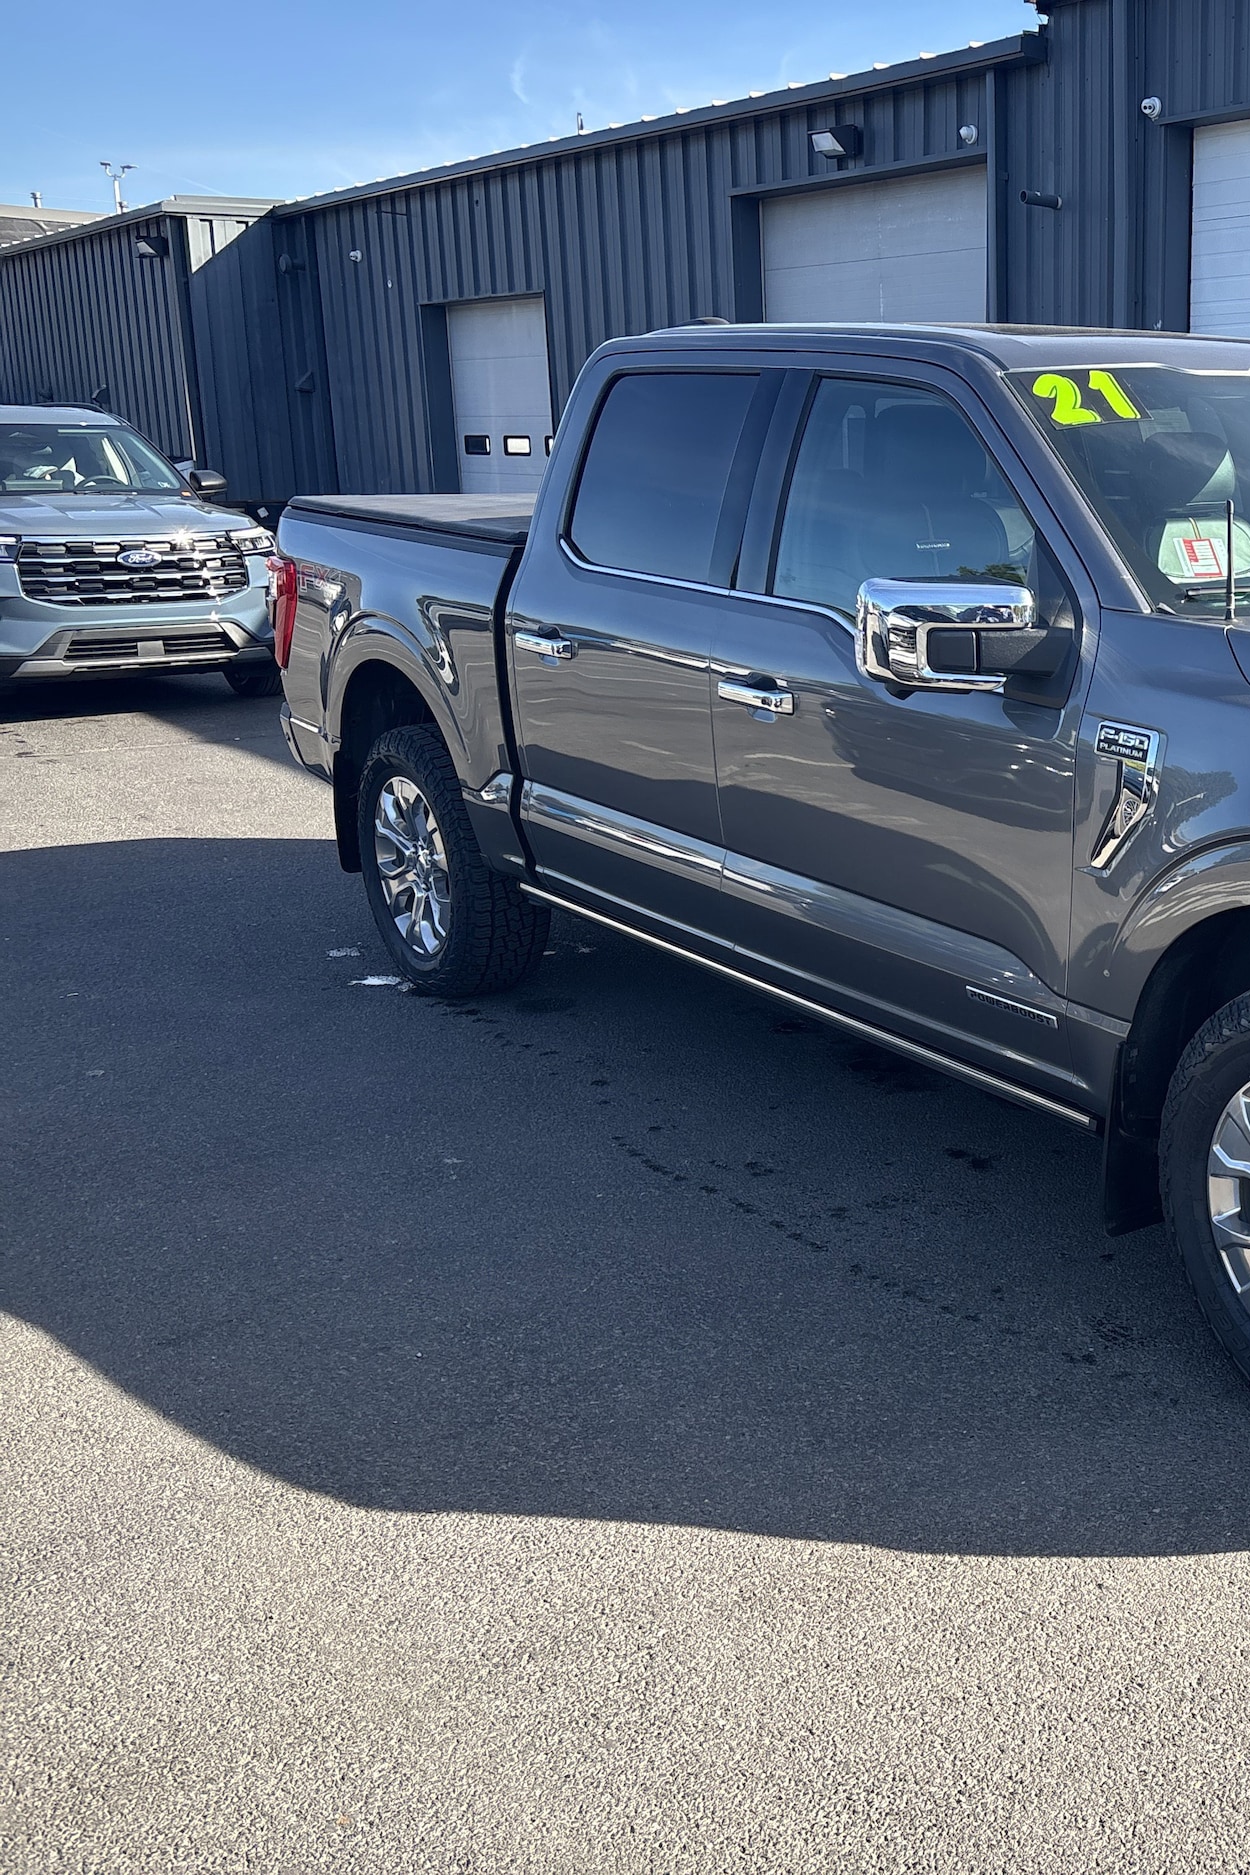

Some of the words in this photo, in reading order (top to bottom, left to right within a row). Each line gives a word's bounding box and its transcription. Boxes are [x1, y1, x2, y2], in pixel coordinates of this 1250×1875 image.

[1032, 370, 1141, 425] 21
[1101, 743, 1142, 758] PLATINUM
[969, 991, 1051, 1025] POWERBOOST
